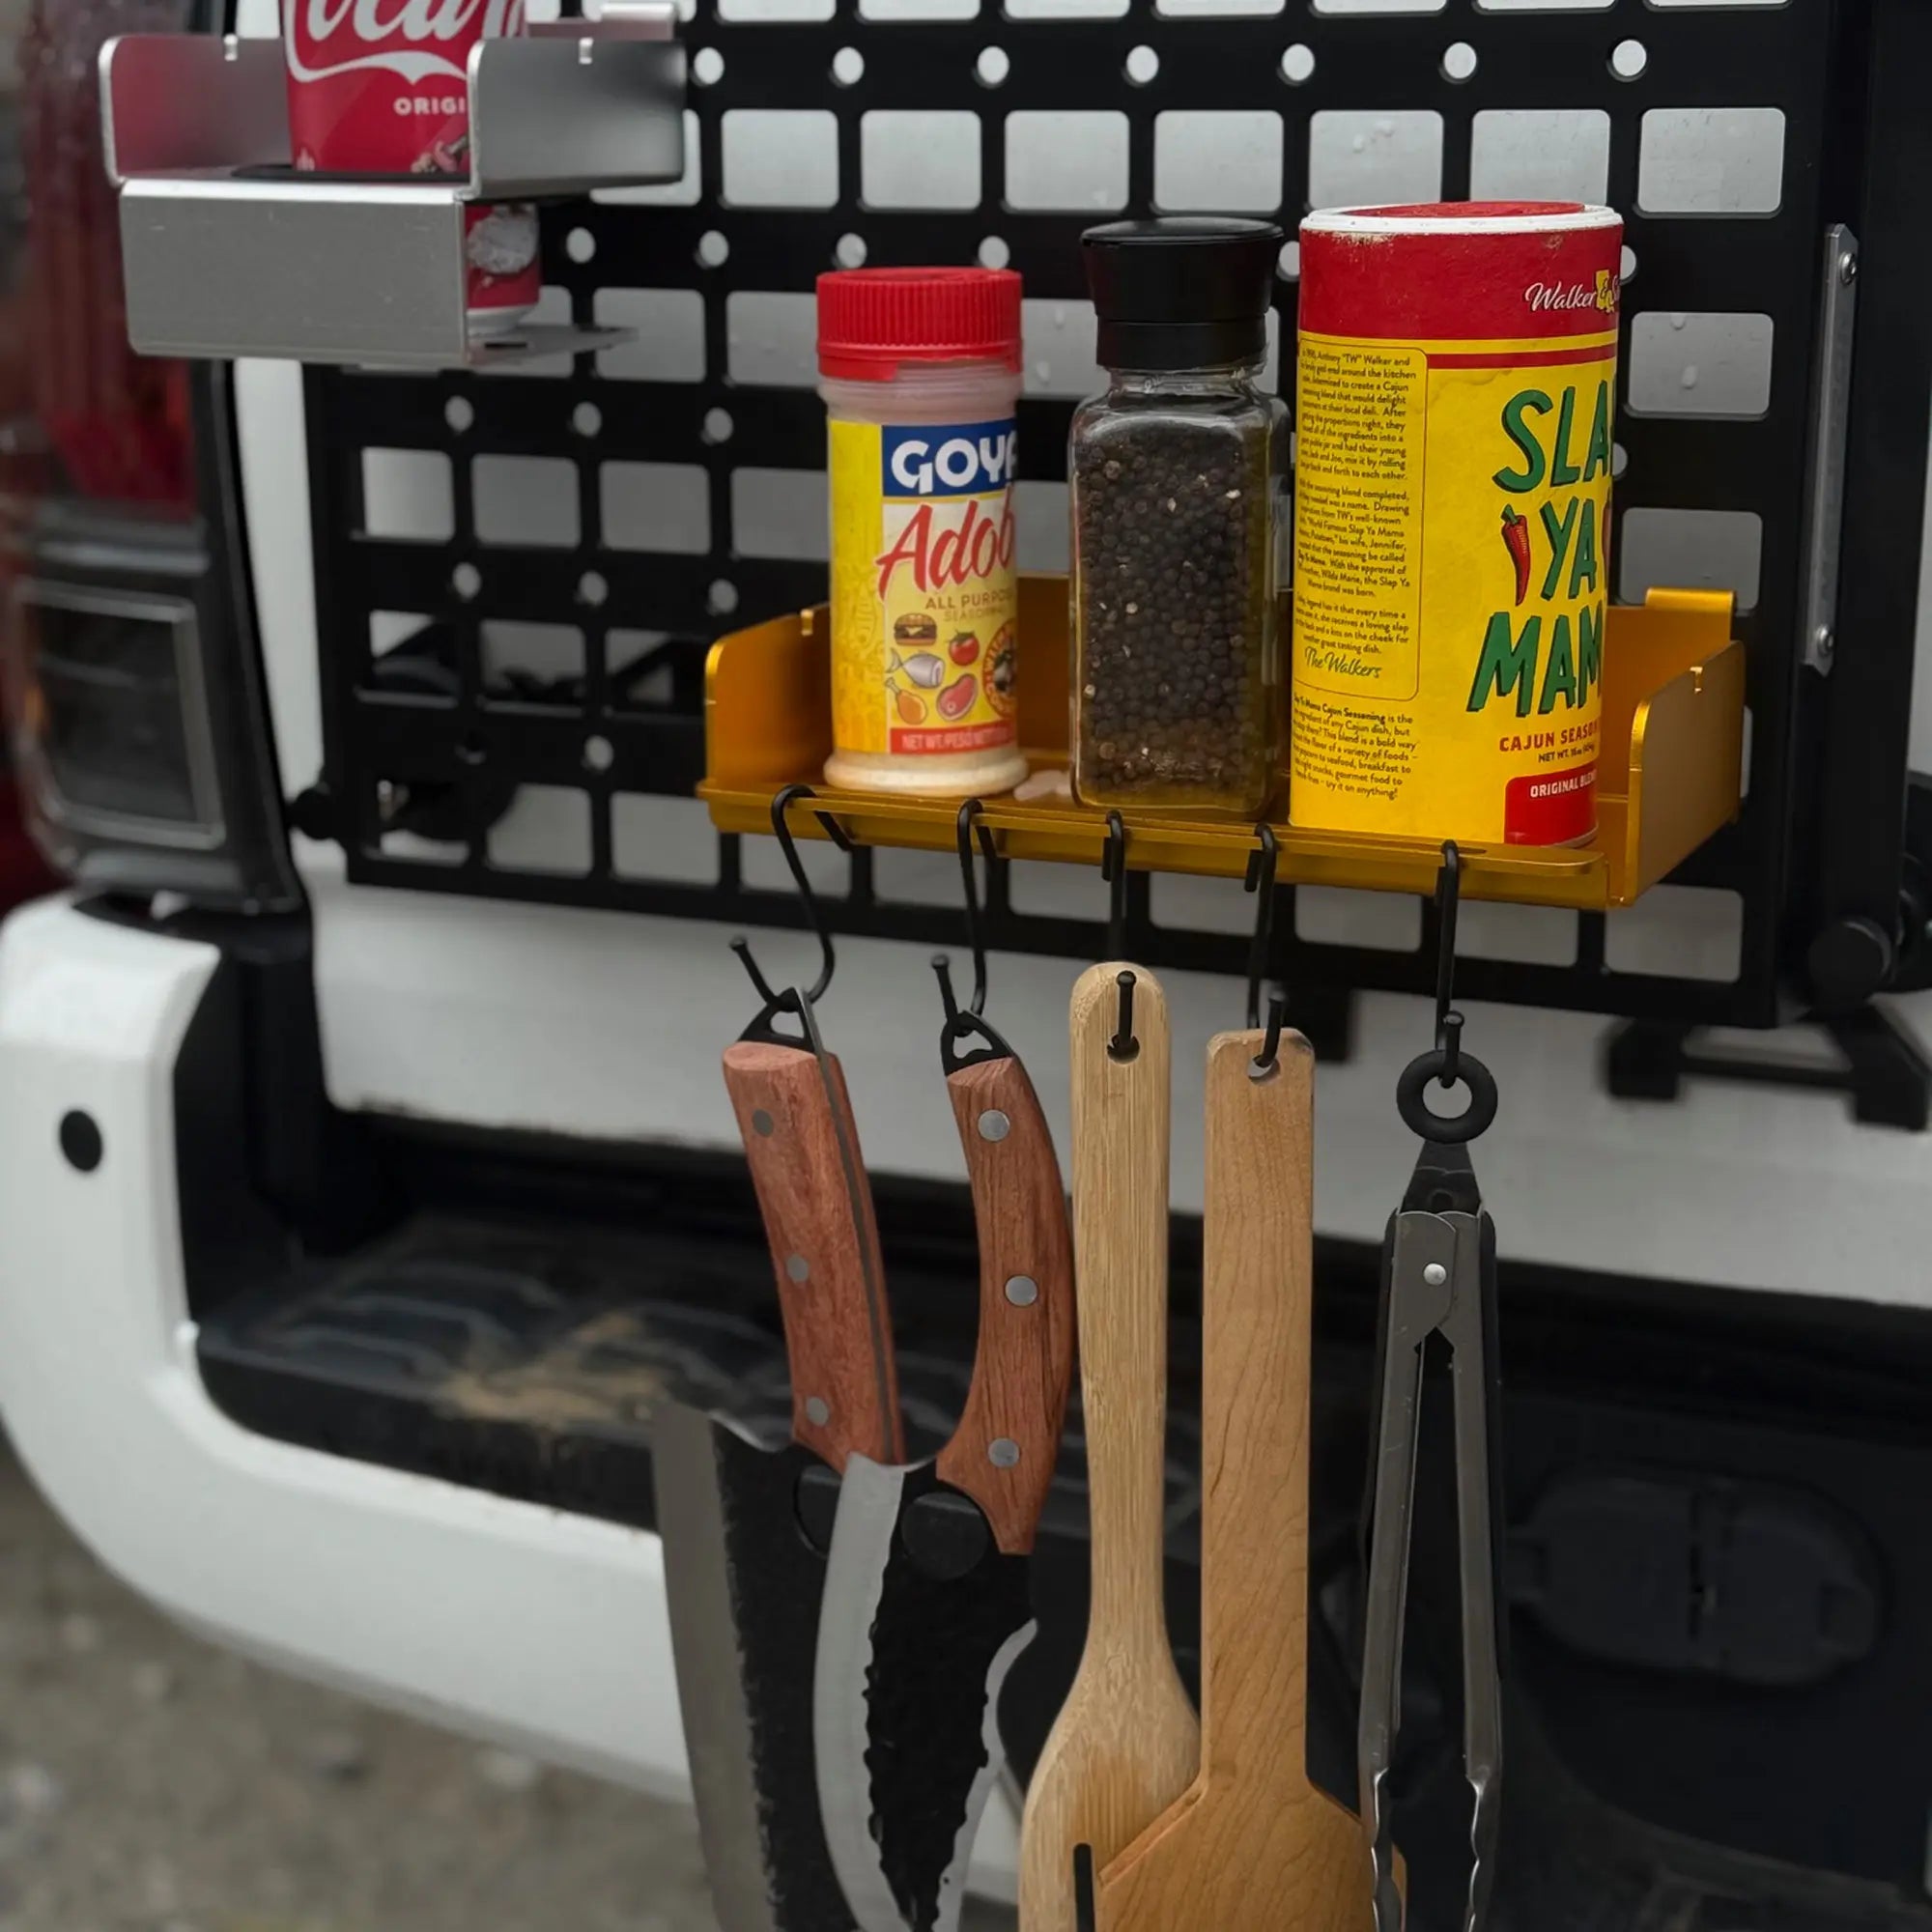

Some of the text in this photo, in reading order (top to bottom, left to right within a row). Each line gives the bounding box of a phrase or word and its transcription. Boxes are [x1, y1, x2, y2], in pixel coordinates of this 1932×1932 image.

[394, 98, 466, 115] ORIGI
[1363, 355, 1392, 365] Walker
[1394, 356, 1410, 366] and
[1368, 367, 1381, 378] the
[1383, 368, 1416, 379] kitchen
[1342, 380, 1350, 388] to
[1350, 382, 1375, 390] create
[1382, 381, 1409, 394] Cajun
[1337, 390, 1351, 401] that
[1352, 393, 1375, 403] would
[1376, 394, 1406, 407] delight
[1344, 405, 1361, 415] local
[1382, 407, 1406, 417] After
[1362, 418, 1384, 432] right,
[1385, 419, 1406, 434] they
[1379, 431, 1397, 442] into
[1492, 380, 1609, 494] SLA
[1345, 441, 1358, 451] had
[1359, 442, 1378, 453] their
[1379, 447, 1406, 459] young
[1359, 456, 1365, 466] it
[1366, 456, 1377, 469] by
[1378, 457, 1406, 471] rolling
[1333, 465, 1350, 476] forth
[1352, 469, 1360, 477] to
[1361, 469, 1379, 478] each
[1381, 470, 1408, 480] other.
[1341, 486, 1361, 497] blend
[1362, 491, 1409, 501] completed,
[1347, 501, 1370, 511] name.
[1374, 502, 1410, 517] Drawing
[1355, 513, 1402, 525] well-known
[1349, 524, 1365, 538] Slap
[1366, 526, 1377, 536] Ya
[1378, 526, 1405, 538] Mama
[876, 483, 1014, 601] Adob
[1339, 534, 1349, 545] his
[1350, 536, 1369, 550] wife,
[1370, 538, 1406, 552] Jennifer,
[1540, 496, 1597, 601] YA
[1333, 548, 1367, 563] seasoning
[1368, 551, 1378, 561] be
[1379, 552, 1405, 562] called
[1330, 557, 1346, 569] With
[1347, 559, 1360, 571] the
[1360, 563, 1395, 577] approval
[1397, 565, 1406, 575] of
[1323, 582, 1341, 593] brand
[1342, 586, 1354, 595] was
[1355, 585, 1376, 597] born.
[1364, 574, 1378, 585] the
[1379, 577, 1398, 589] Slap
[1400, 577, 1410, 587] Ya
[925, 586, 1013, 611] ALL PURPO
[1340, 603, 1354, 613] that
[1356, 609, 1377, 620] every
[1378, 610, 1399, 619] time
[1365, 619, 1390, 634] loving
[1392, 621, 1409, 635] slap
[1354, 629, 1368, 640] the
[1369, 631, 1394, 642] cheek
[1395, 633, 1408, 643] for
[1337, 640, 1362, 655] tasting
[1363, 643, 1381, 654] dish.
[1304, 645, 1382, 679] The Walkers
[1466, 606, 1603, 718] MAM
[1321, 703, 1342, 720] Cajun
[1344, 707, 1386, 725] Seasoning
[1387, 715, 1395, 724] is
[1397, 714, 1413, 724] the
[1331, 720, 1344, 735] any
[1345, 720, 1370, 735] Cajun
[1371, 724, 1392, 736] dish,
[1394, 725, 1410, 736] but
[1499, 720, 1598, 752] CAJUN SEASO
[1338, 730, 1359, 744] blend
[1360, 736, 1367, 746] is
[1377, 737, 1396, 748] bold
[1398, 742, 1418, 753] way
[1328, 741, 1336, 753] of
[1343, 747, 1371, 760] variety
[1373, 749, 1382, 759] of
[1383, 750, 1409, 761] foods
[1538, 752, 1555, 763] NET
[1320, 753, 1411, 774] to seafood, breakfast to
[1335, 770, 1369, 782] gourmet
[1370, 773, 1390, 784] food
[1392, 777, 1403, 786] to
[1337, 782, 1344, 792] it
[1345, 784, 1355, 793] on
[1356, 785, 1398, 801] anything!
[1530, 777, 1578, 798] ORIGINAL
